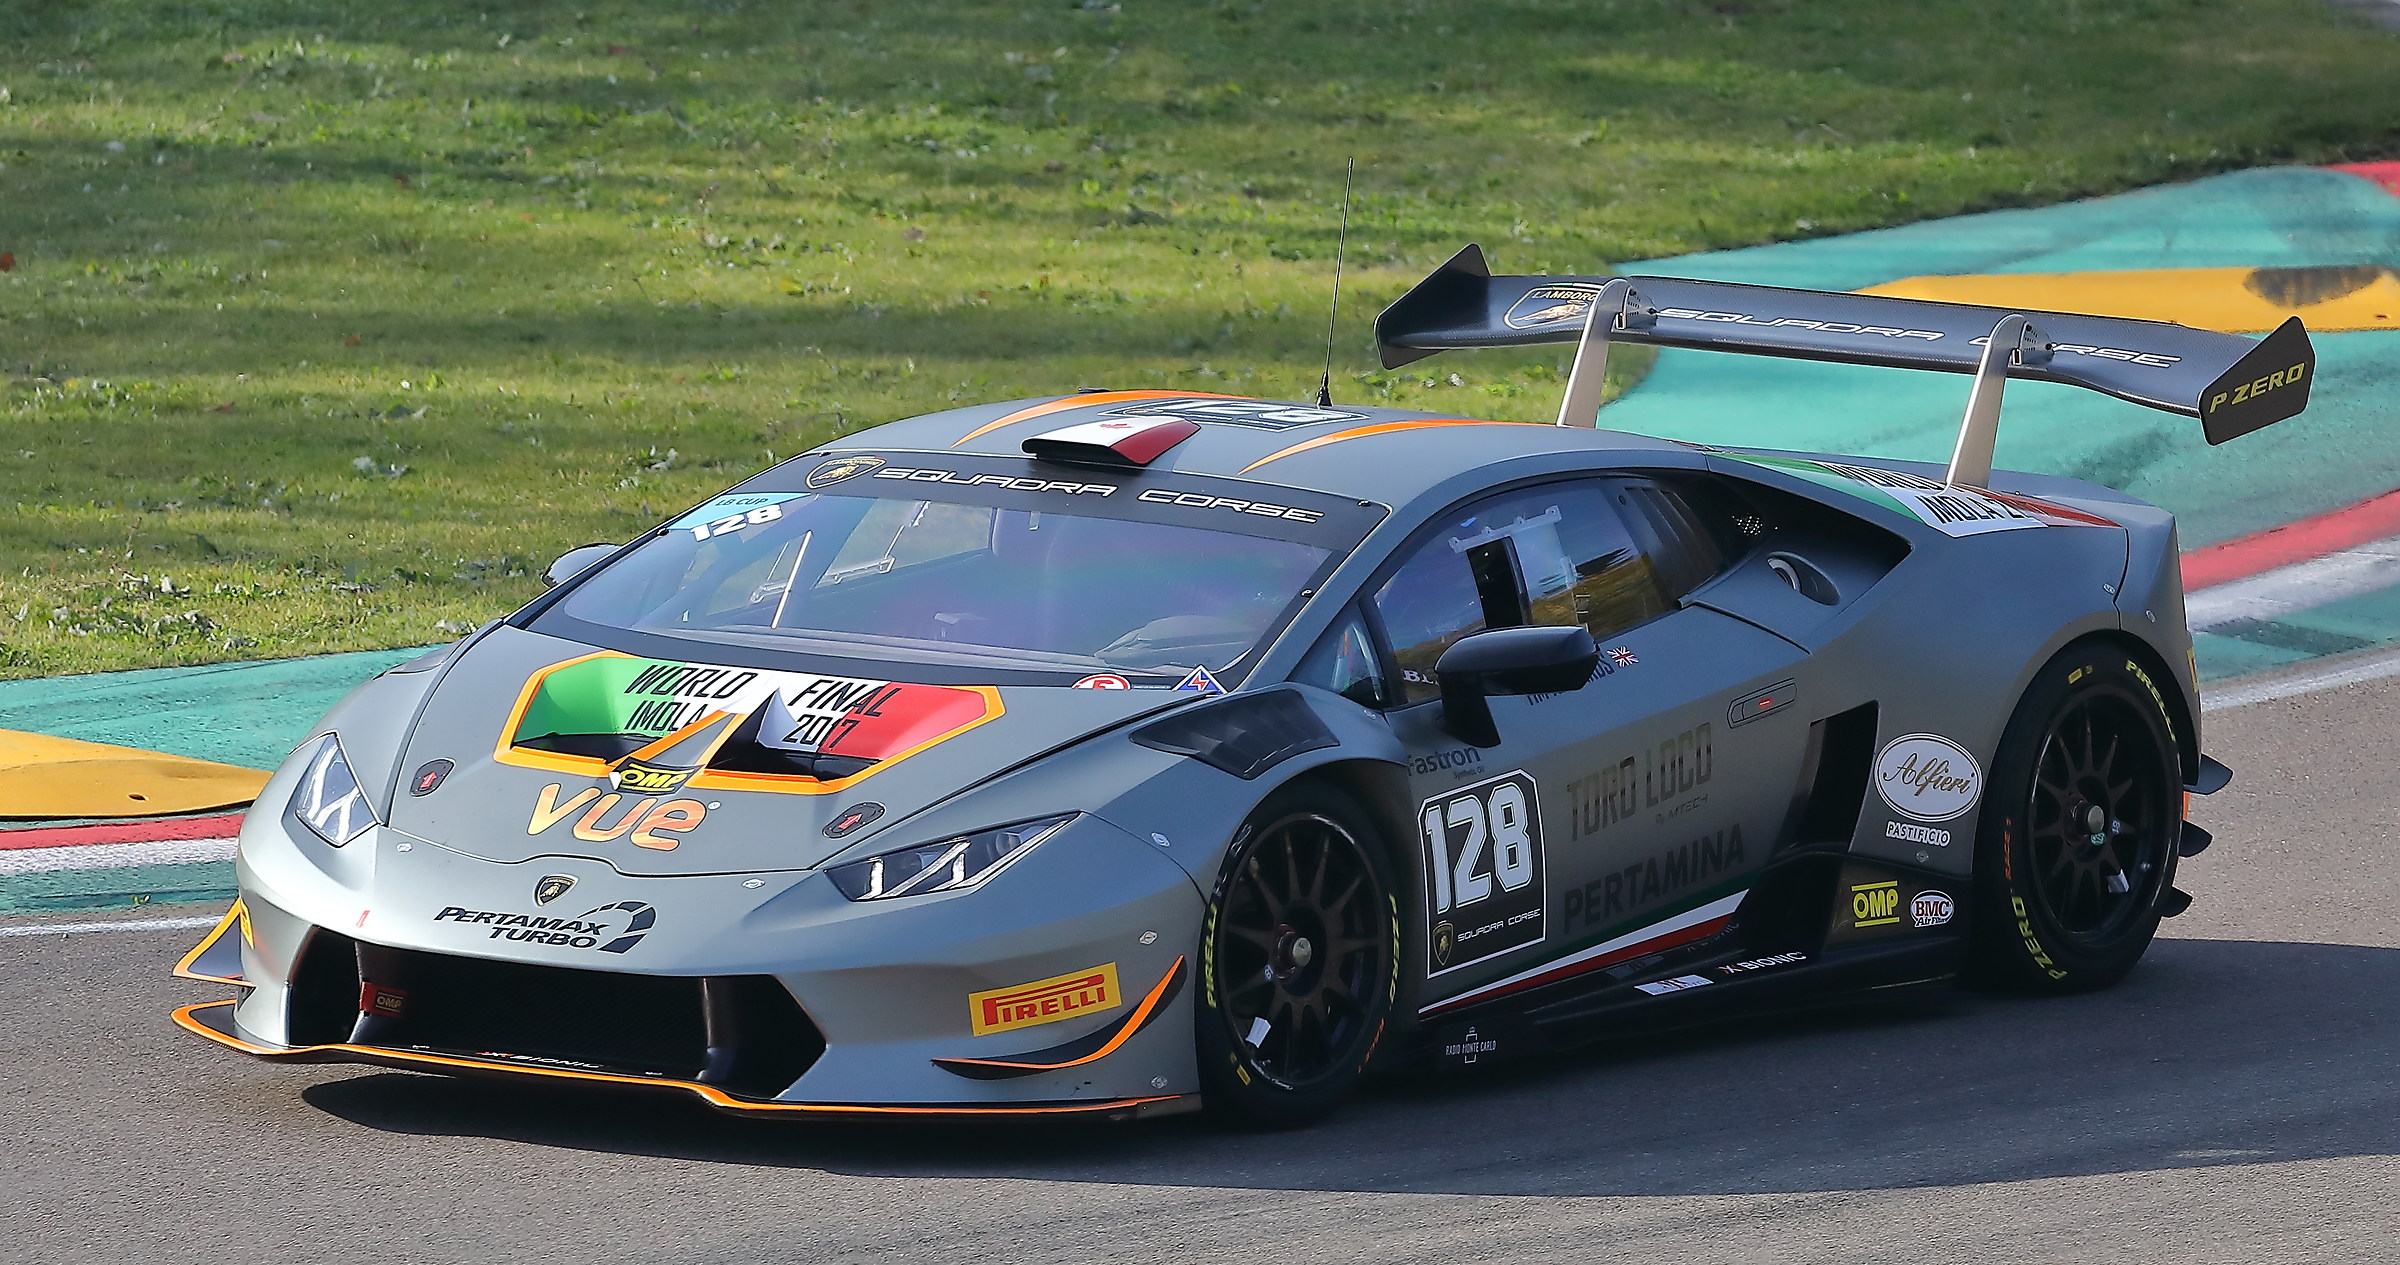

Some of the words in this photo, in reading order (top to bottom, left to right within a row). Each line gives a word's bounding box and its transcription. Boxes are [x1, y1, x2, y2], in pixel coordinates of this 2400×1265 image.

[1657, 307, 1945, 341] SQUADRA
[1967, 335, 2182, 368] RSE
[2209, 391, 2227, 414] P
[2232, 361, 2306, 407] ZERO
[736, 497, 769, 507] CUP
[872, 466, 1118, 498] SQUADRA
[1137, 488, 1325, 524] CORSE
[689, 503, 783, 542] 128
[624, 664, 758, 699] WORLD
[787, 678, 903, 717] FINAL
[624, 700, 708, 731] IMOLA
[781, 713, 860, 749] 2017
[620, 769, 687, 790] OMP
[1566, 755, 1637, 842] TORO
[1646, 721, 1713, 809] LOCO
[1883, 753, 1974, 797] Alfieri
[526, 783, 707, 852] vue
[1885, 821, 1951, 847] PASTIFICIO
[1425, 781, 1534, 915] 128
[1564, 823, 1745, 935] PERTAMINA
[433, 906, 611, 936] PERTAMAX
[1457, 920, 1504, 942] SQUADRA
[1507, 908, 1541, 926] CORSE
[1853, 888, 1899, 919] OMP
[1915, 900, 1950, 917] BMC
[488, 926, 598, 949] TURBO
[1741, 950, 1808, 971] BIONIC
[982, 972, 1106, 1027] PIRELLI
